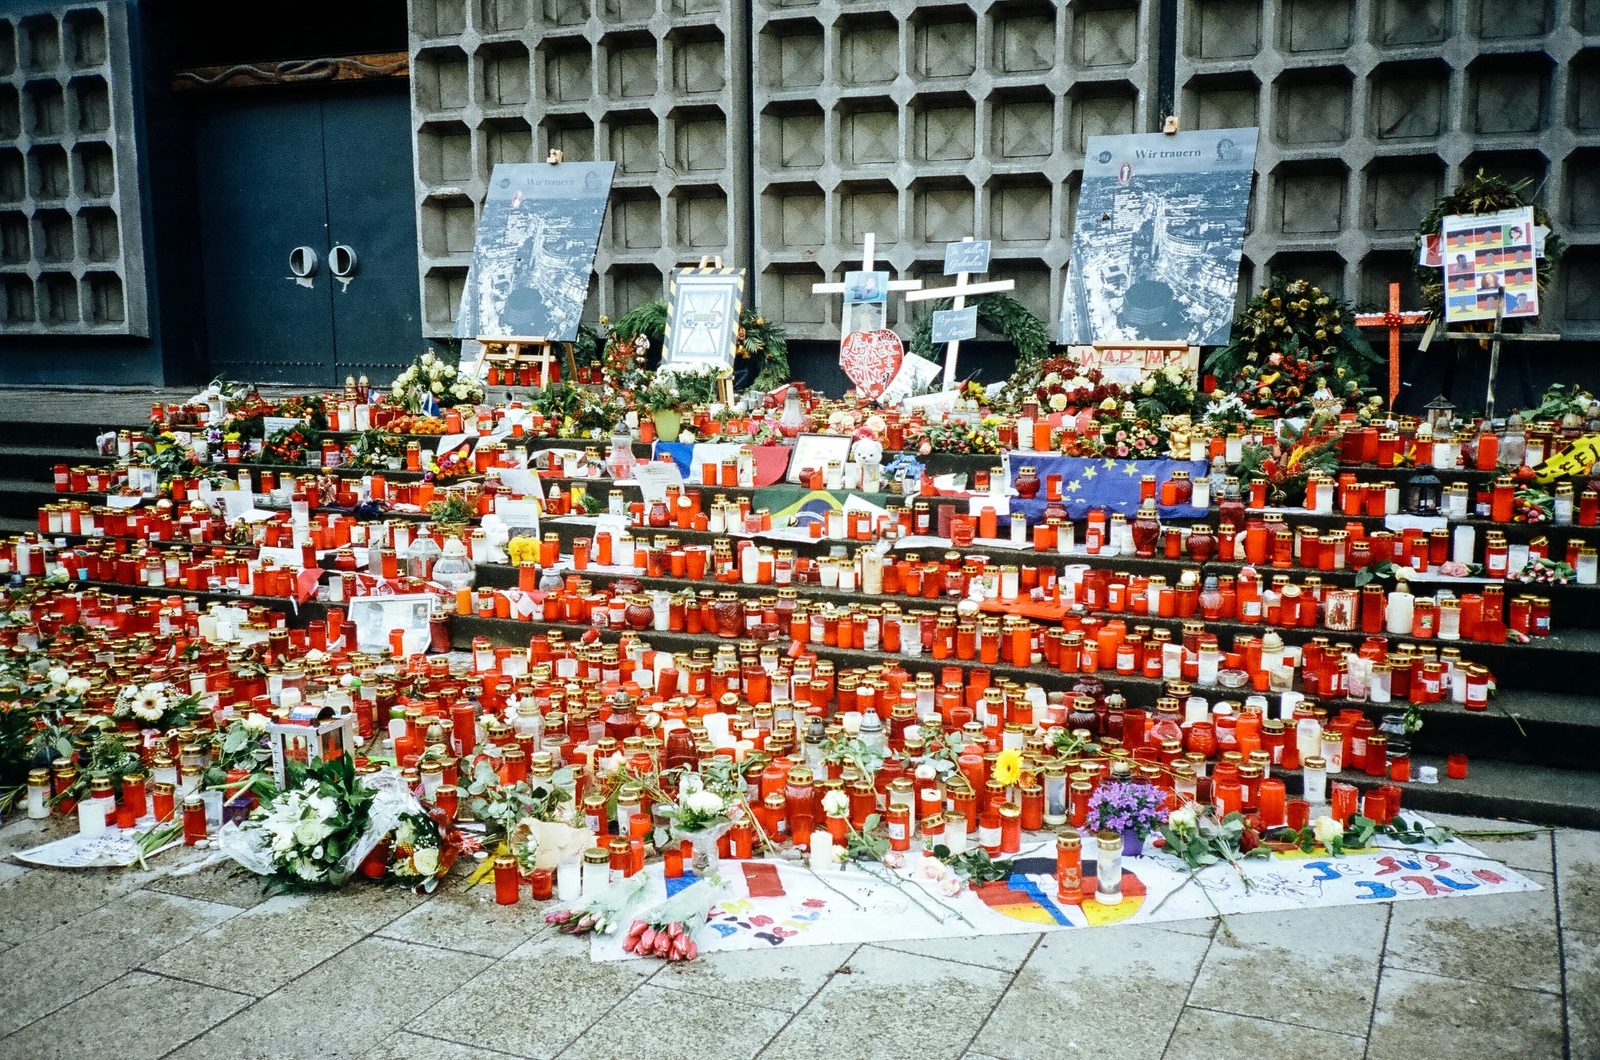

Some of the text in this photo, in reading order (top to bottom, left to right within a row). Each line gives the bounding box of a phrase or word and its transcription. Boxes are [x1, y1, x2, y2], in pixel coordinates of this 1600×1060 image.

[1135, 149, 1201, 159] Wir trauern
[526, 178, 575, 186] Wir trauern
